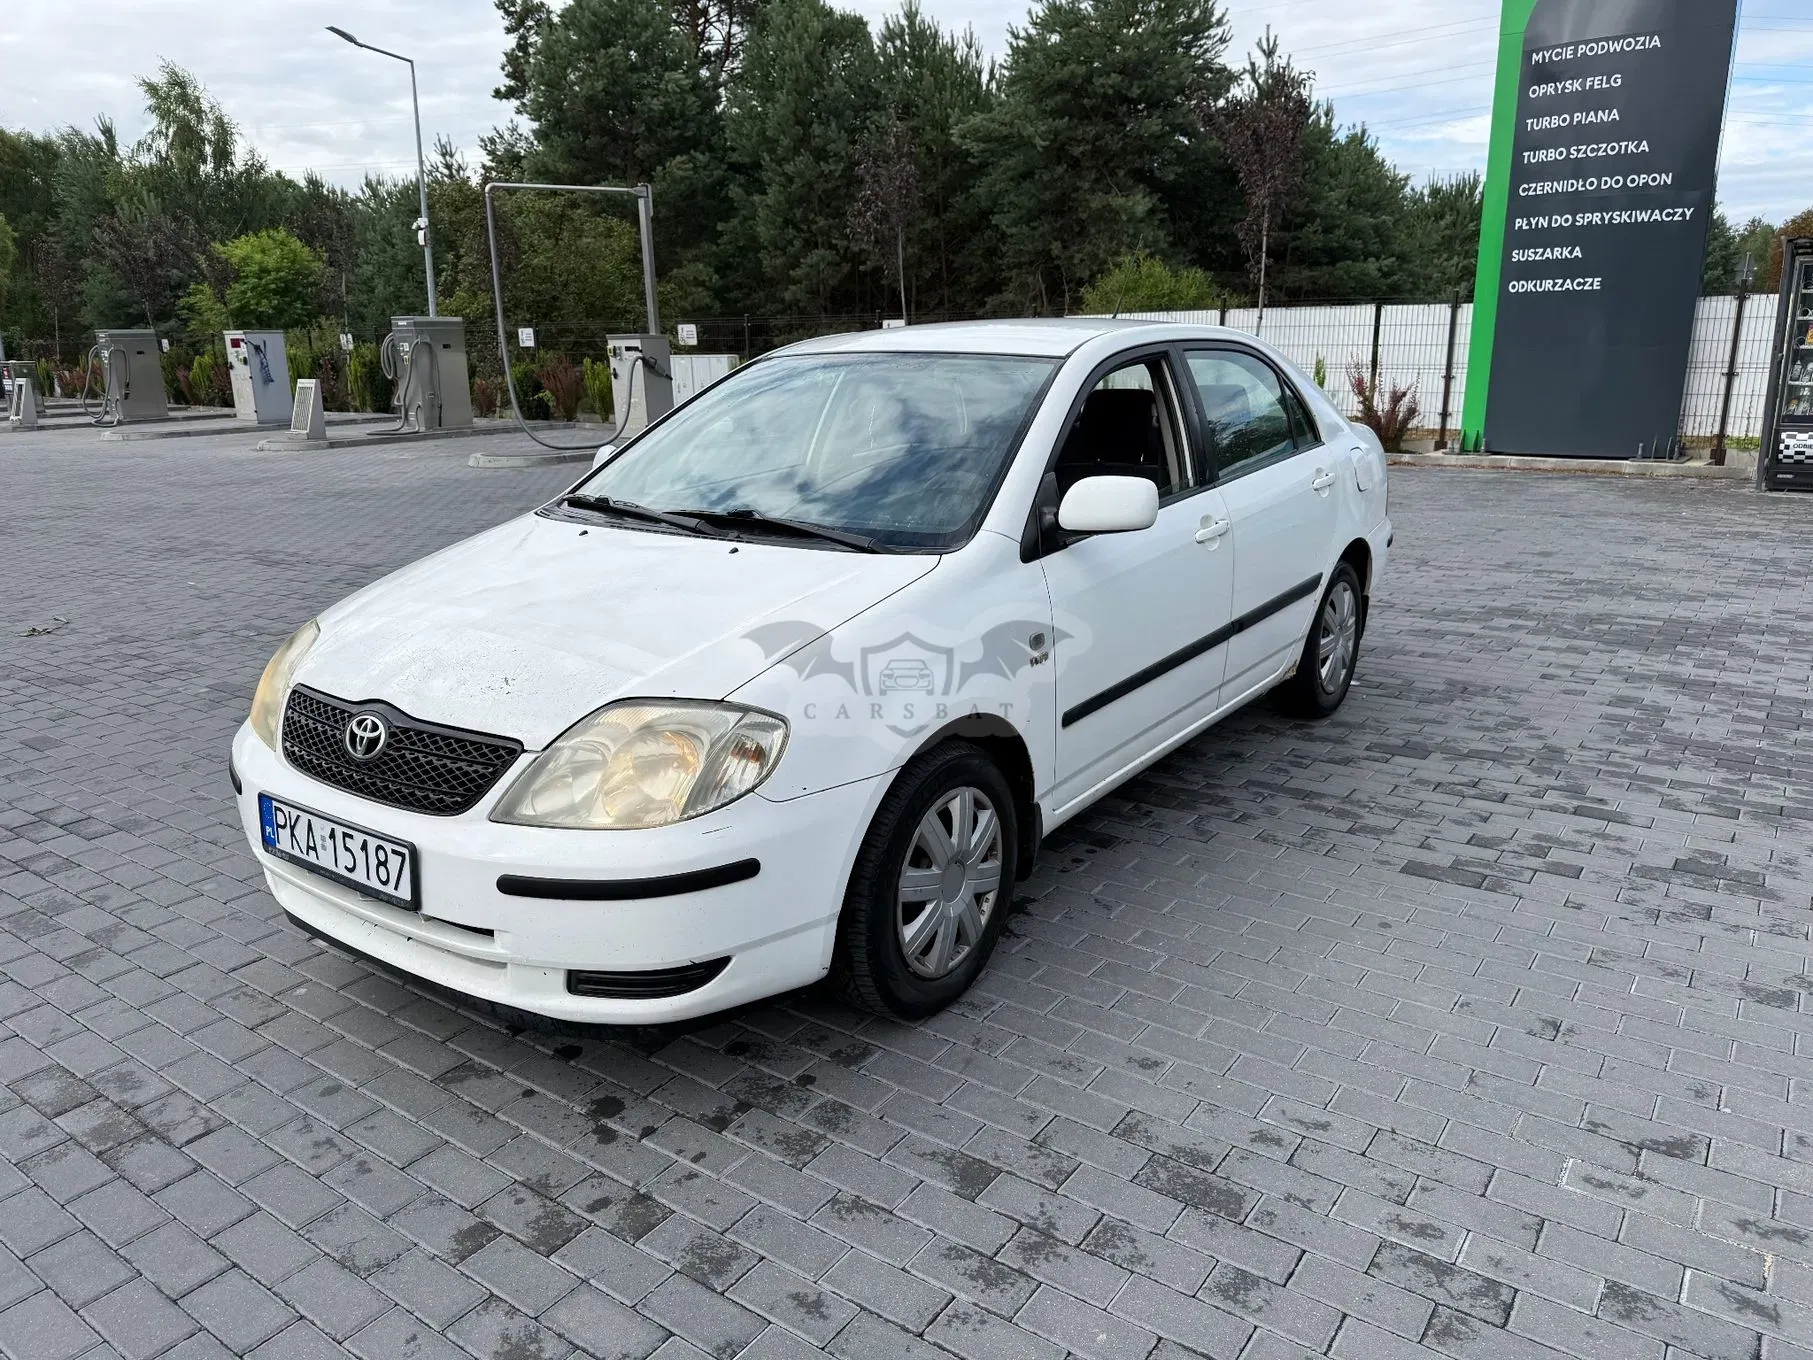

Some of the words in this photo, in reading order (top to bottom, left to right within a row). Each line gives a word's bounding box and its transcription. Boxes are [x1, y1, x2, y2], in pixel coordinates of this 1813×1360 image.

[1531, 45, 1575, 65] MYCIE
[1577, 34, 1662, 58] PODWOZIA
[1528, 78, 1583, 99] OPRYSK
[1585, 73, 1622, 91] FELG
[1525, 113, 1570, 132] TURBO
[1572, 108, 1620, 126] PIANA
[1522, 147, 1567, 164] TURBO
[1569, 139, 1650, 159] SZCZOTKA
[1518, 177, 1598, 197] CZERNIDŁO
[1600, 175, 1624, 190] DO
[1626, 172, 1673, 188] OPON
[1514, 215, 1549, 231] PŁYN
[1551, 214, 1573, 228] DO
[1574, 207, 1695, 226] SPRYSKIWACZY
[1511, 246, 1583, 262] SUSZARKA
[1508, 277, 1602, 293] ODKURZACZE
[265, 825, 275, 839] PL
[273, 805, 320, 861] PKA
[328, 827, 407, 891] 15187
